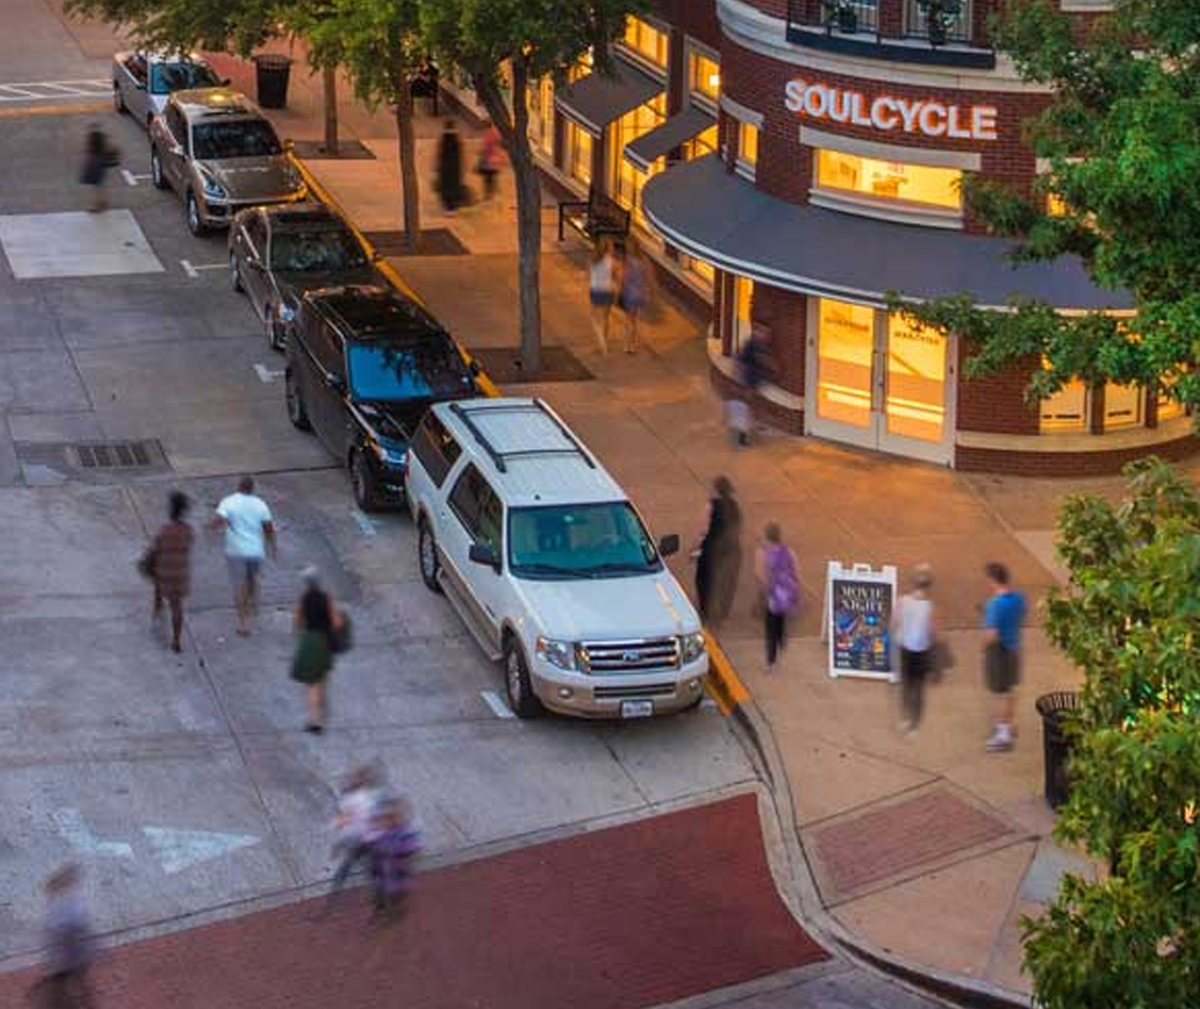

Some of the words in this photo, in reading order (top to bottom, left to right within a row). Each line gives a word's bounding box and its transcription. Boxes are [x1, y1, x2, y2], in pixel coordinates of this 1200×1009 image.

[785, 79, 998, 140] SOULCYCLE
[840, 584, 884, 598] MOVIE
[841, 599, 883, 612] NIGHT
